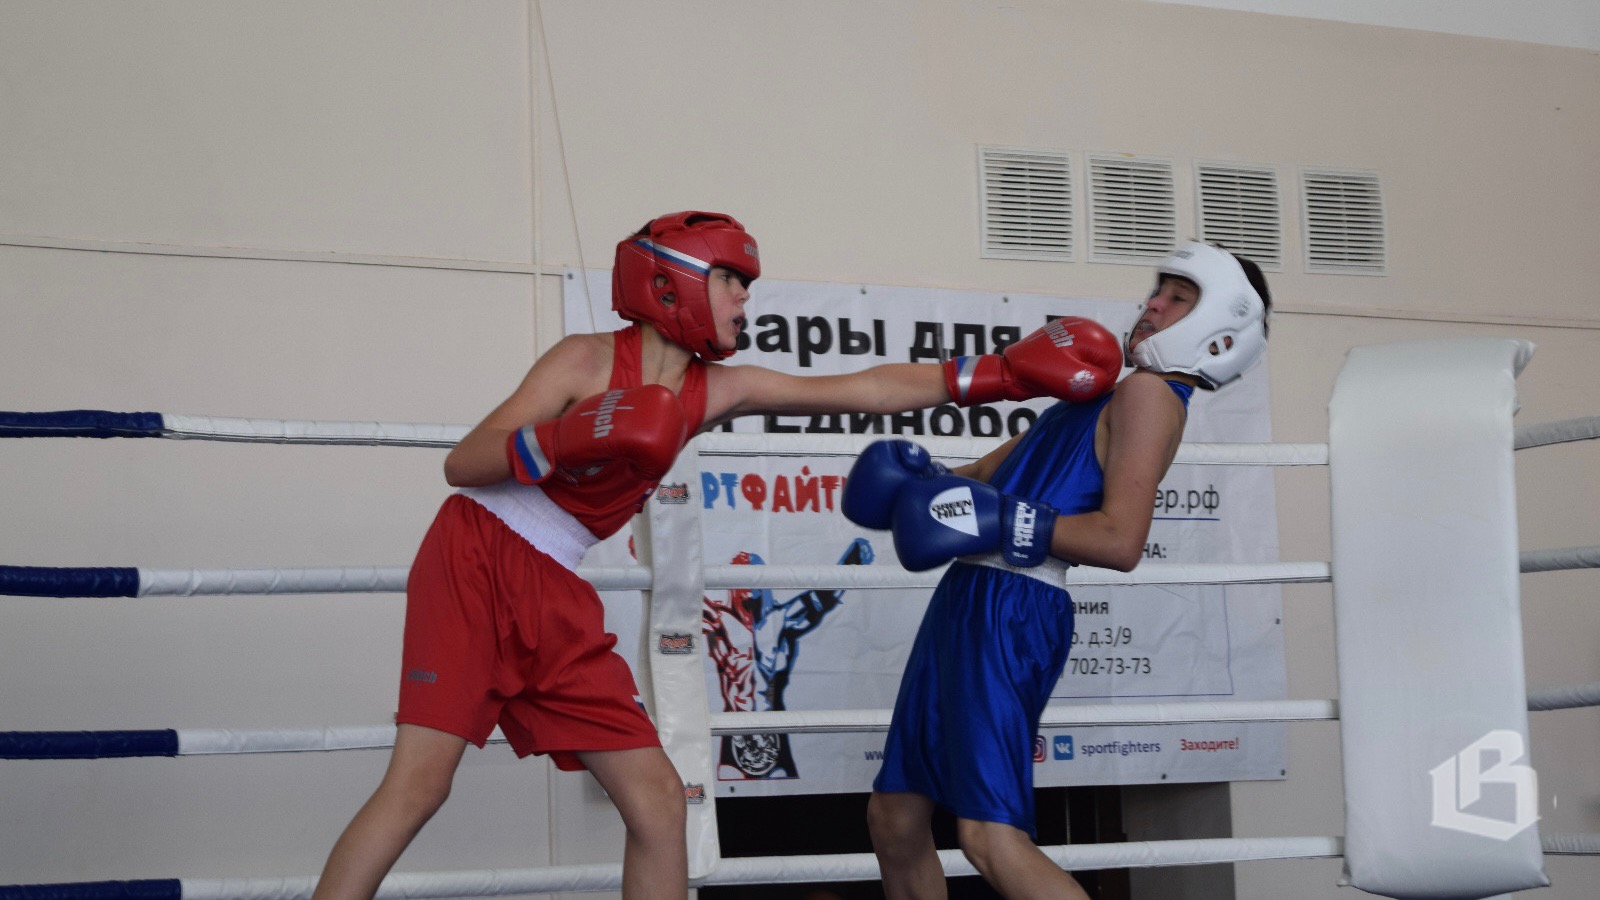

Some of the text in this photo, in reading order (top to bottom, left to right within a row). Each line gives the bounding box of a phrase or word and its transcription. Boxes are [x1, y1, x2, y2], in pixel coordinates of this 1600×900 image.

[909, 321, 1021, 364] для
[701, 465, 848, 513] РТФАЙТ
[931, 499, 972, 512] GREEN
[936, 506, 971, 519] HILL
[1088, 626, 1132, 648] д.3/9
[1070, 657, 1152, 675] 702-73-73
[1081, 741, 1161, 757] sportfighters
[1180, 737, 1239, 752] Заходите!
